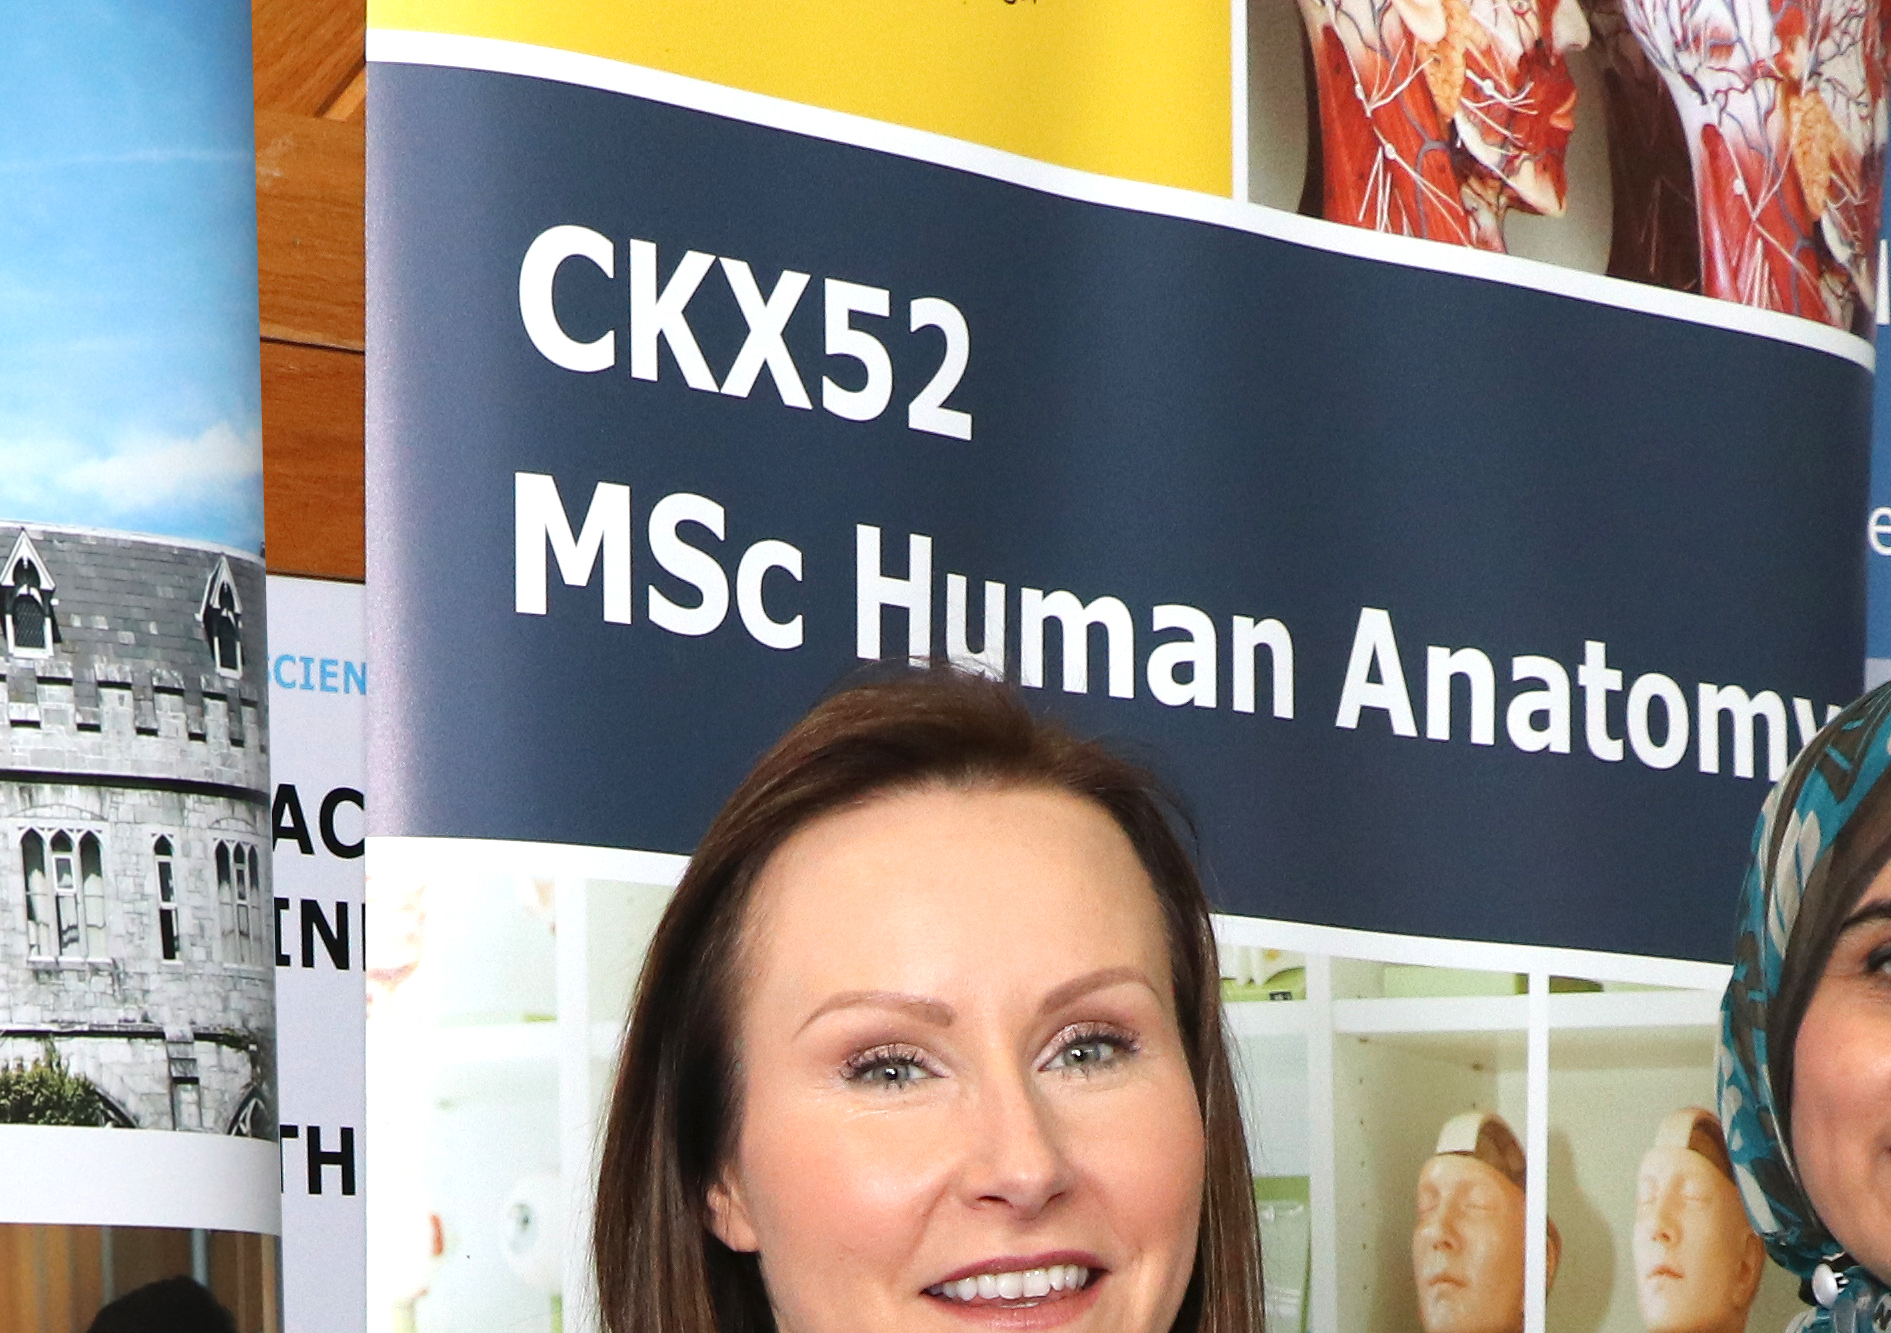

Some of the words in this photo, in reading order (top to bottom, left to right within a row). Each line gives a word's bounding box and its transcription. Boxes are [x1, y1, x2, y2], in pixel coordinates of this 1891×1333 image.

[517, 224, 973, 441] CKX52
[513, 470, 805, 650] MSc
[855, 522, 1296, 720] Human
